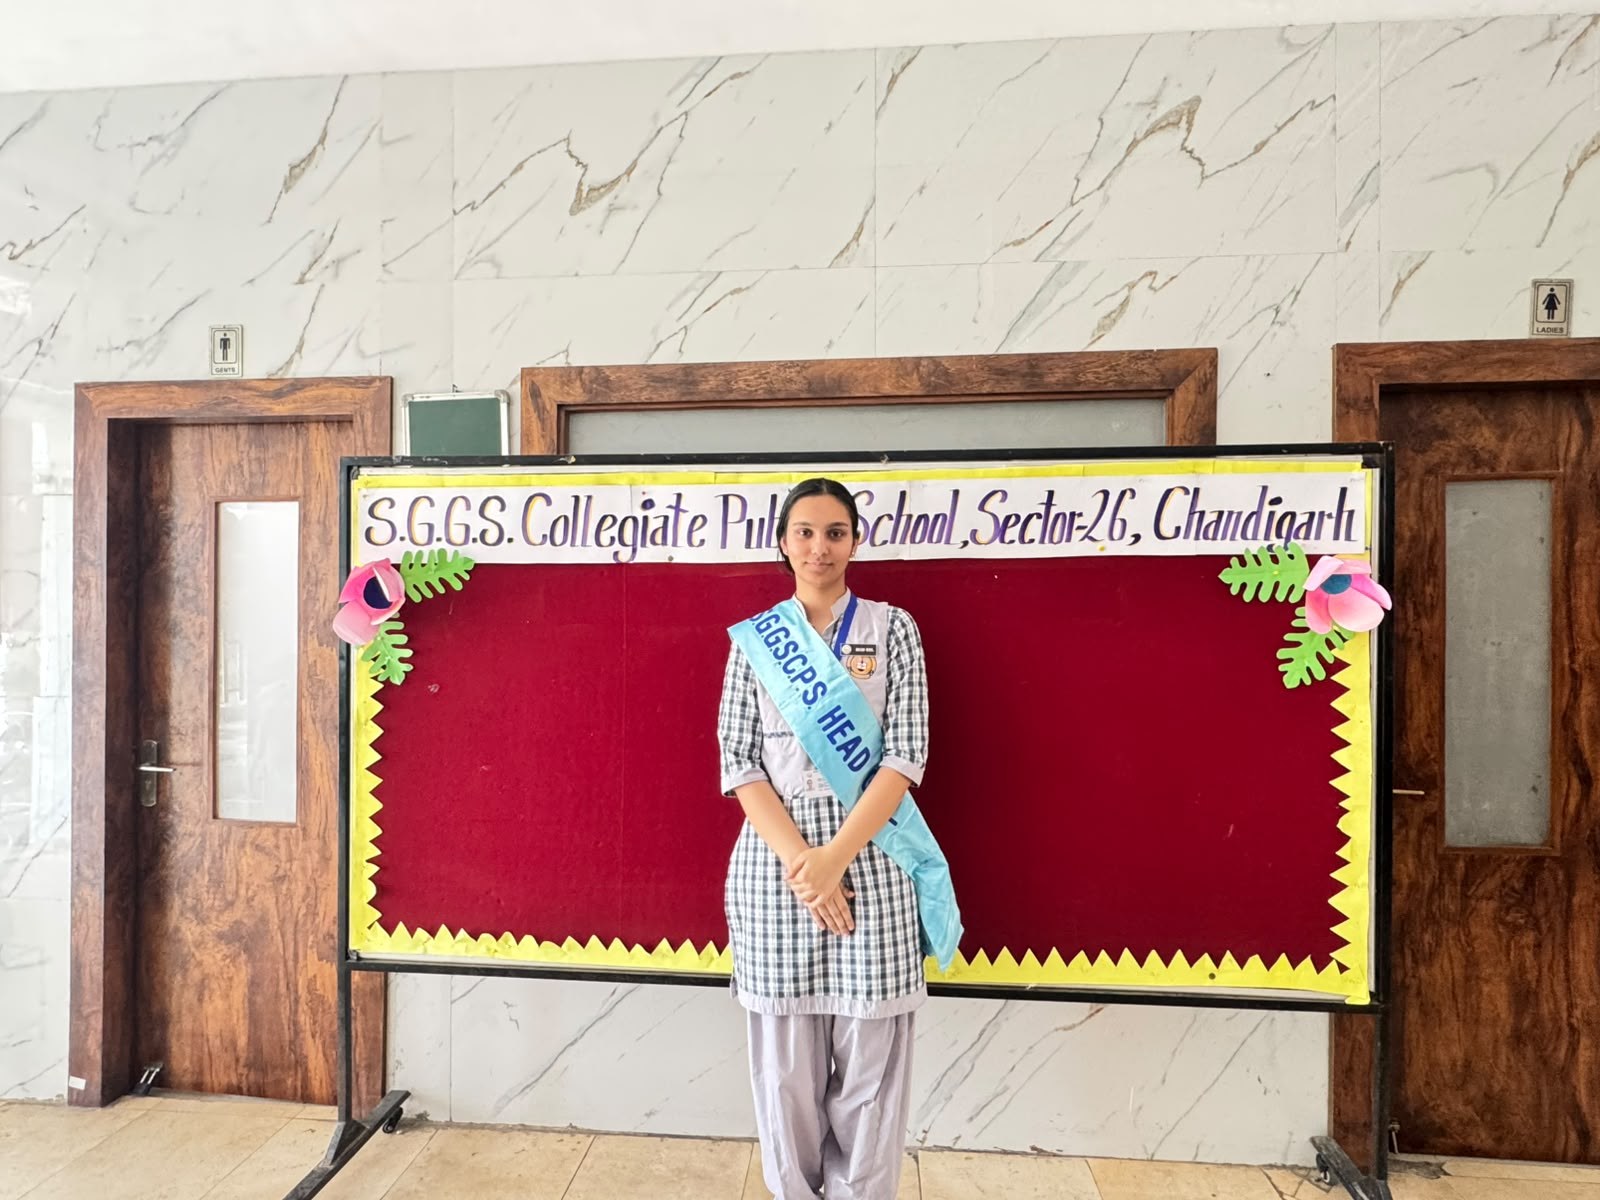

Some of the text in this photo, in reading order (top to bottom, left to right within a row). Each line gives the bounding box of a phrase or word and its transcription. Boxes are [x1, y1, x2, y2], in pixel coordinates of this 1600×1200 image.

[1536, 326, 1564, 334] LADIES
[364, 494, 514, 547] S.G.G.S.
[521, 492, 708, 564] Collegiate
[1153, 485, 1358, 553] Chandigarh
[817, 705, 871, 773] HEAD
